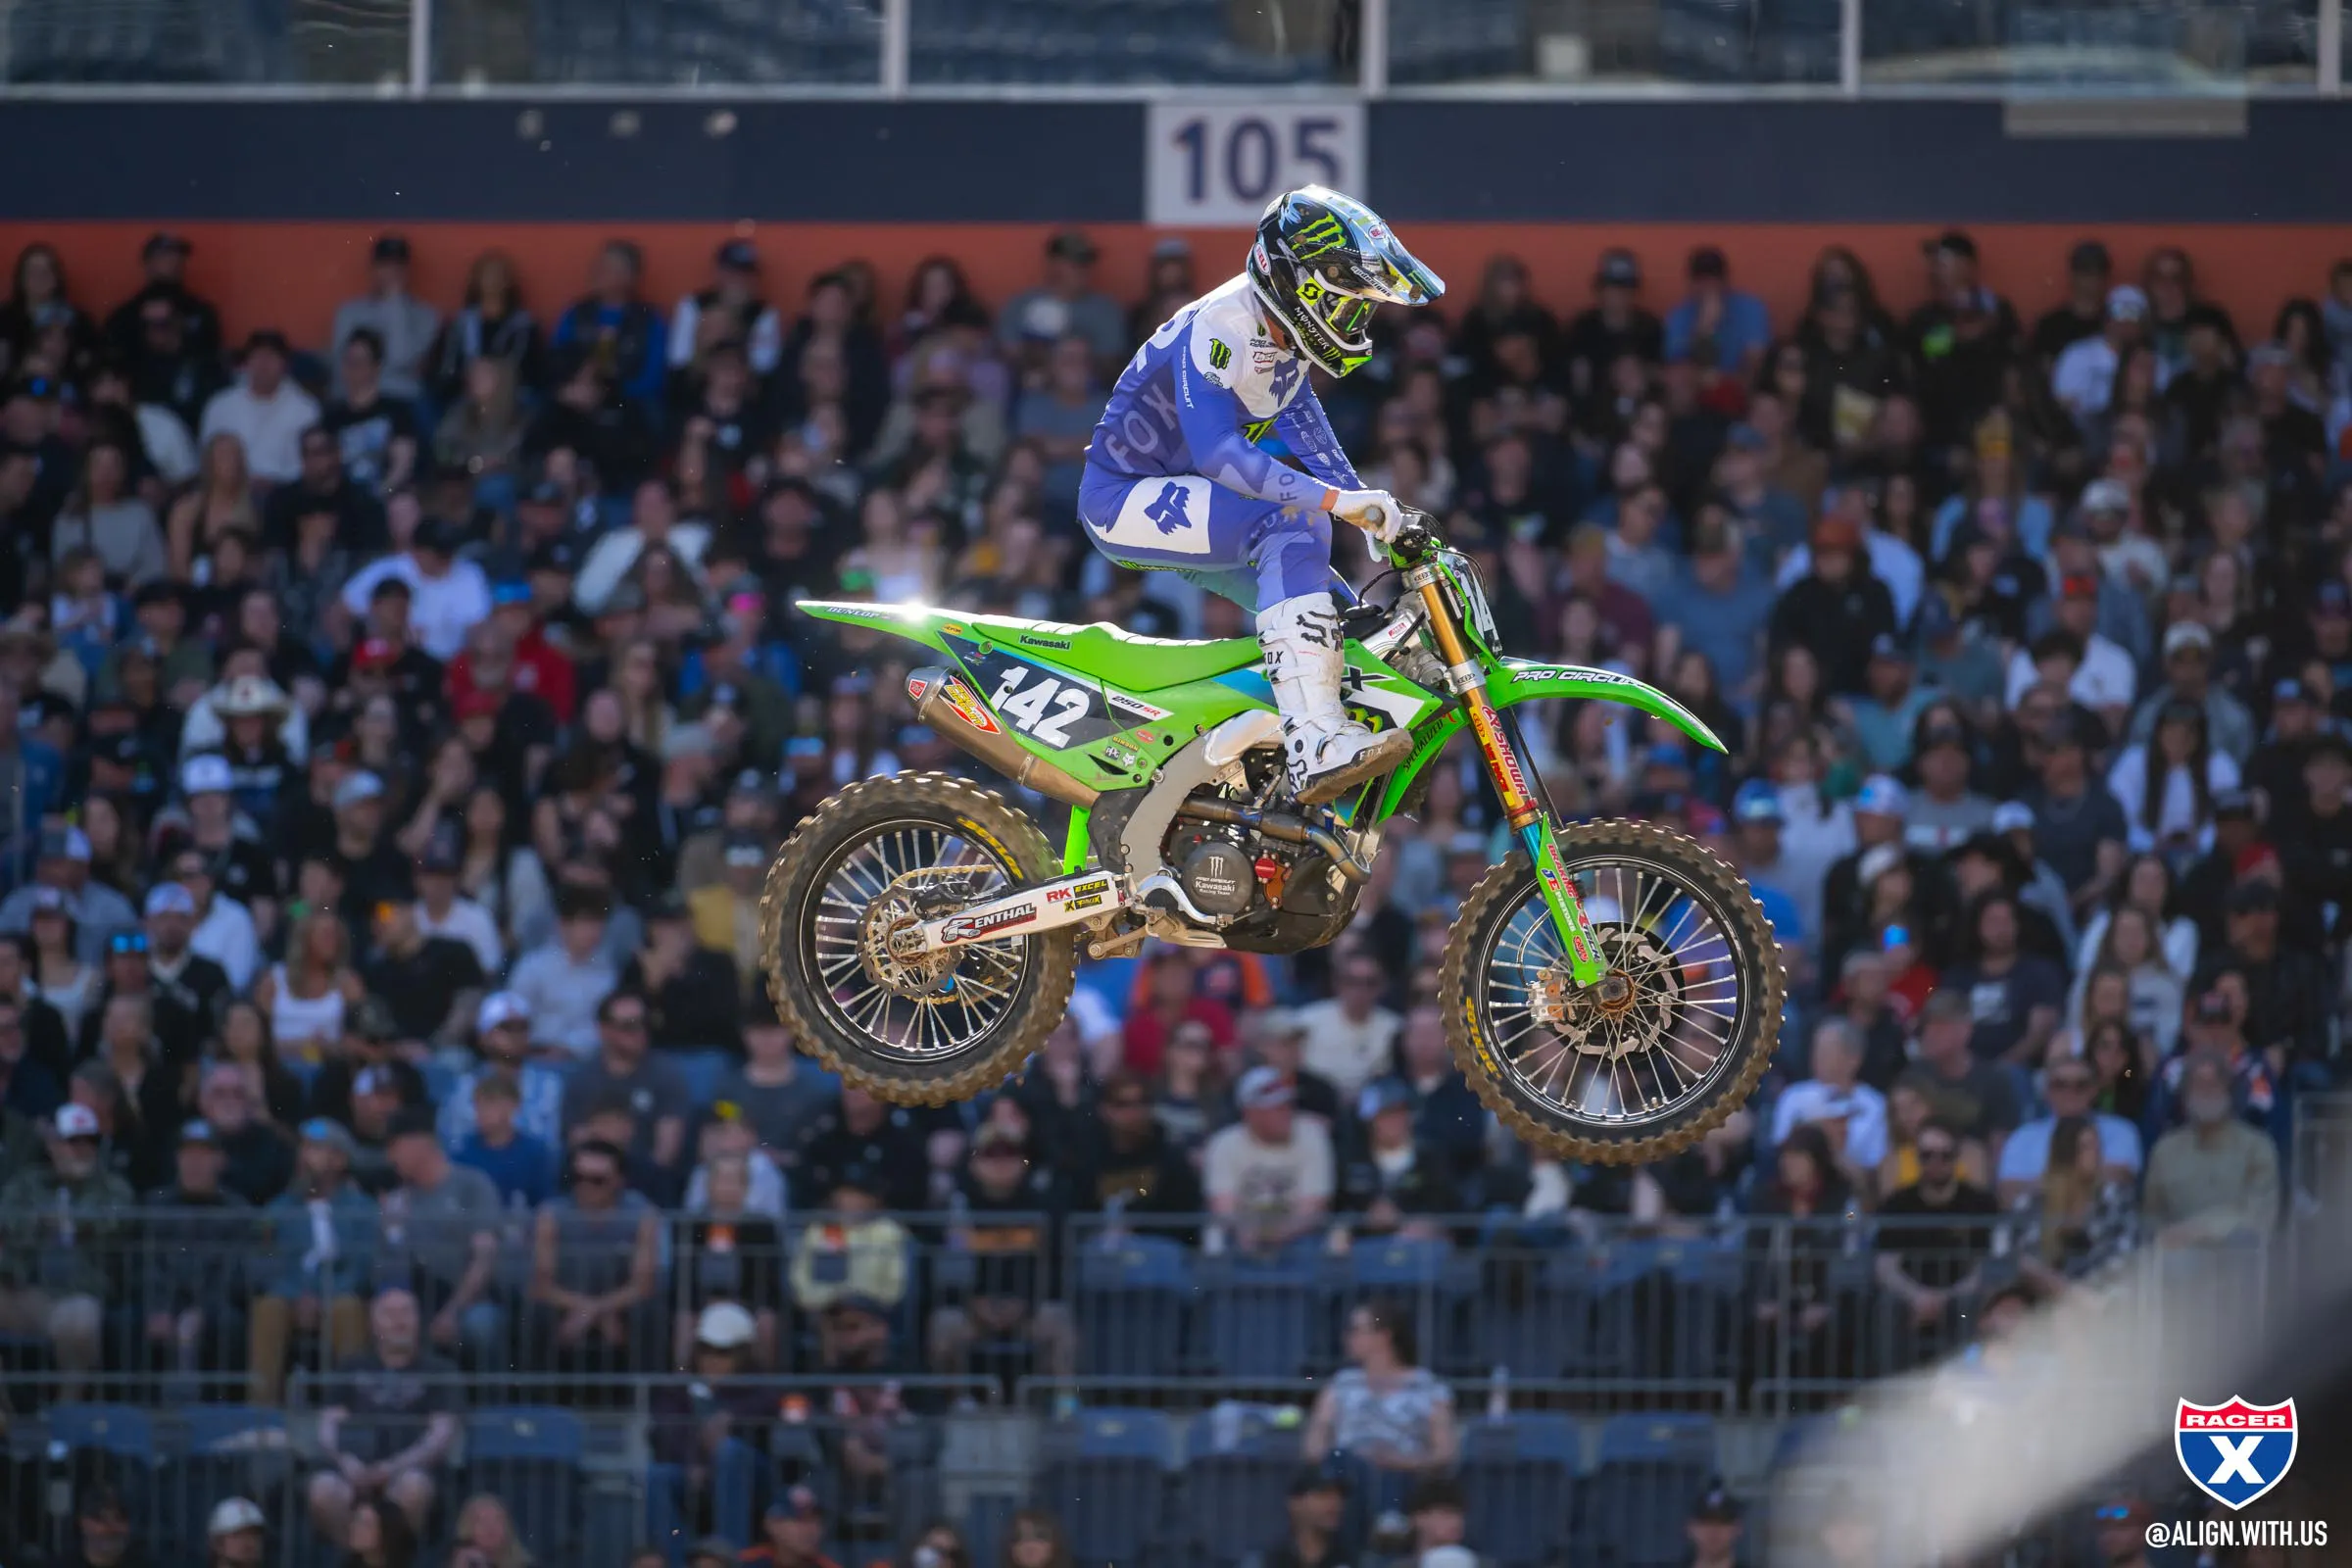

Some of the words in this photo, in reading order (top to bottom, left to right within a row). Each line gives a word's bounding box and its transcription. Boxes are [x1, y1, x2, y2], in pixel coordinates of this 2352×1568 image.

[1173, 116, 1343, 202] 105
[1256, 246, 1267, 271] BELL
[1295, 307, 1330, 350] MONSTER
[1182, 370, 1195, 410] CIRCUIT
[1105, 382, 1178, 473] FOX
[1279, 472, 1298, 502] FO
[826, 607, 880, 618] DUNLOP
[1020, 634, 1071, 650] Kawasaki
[1510, 670, 1556, 683] PRO
[990, 666, 1090, 749] 142
[1359, 746, 1383, 761] FOX
[1403, 718, 1444, 773] SPECIALIZED
[1494, 732, 1529, 796] SHOWA
[1046, 887, 1072, 903] RK
[1075, 881, 1106, 893] EXCEL
[1196, 881, 1235, 892] Kawasaki
[1542, 868, 1561, 891] JE
[1555, 890, 1576, 932] PISTONS
[942, 903, 1036, 944] RENTHAL
